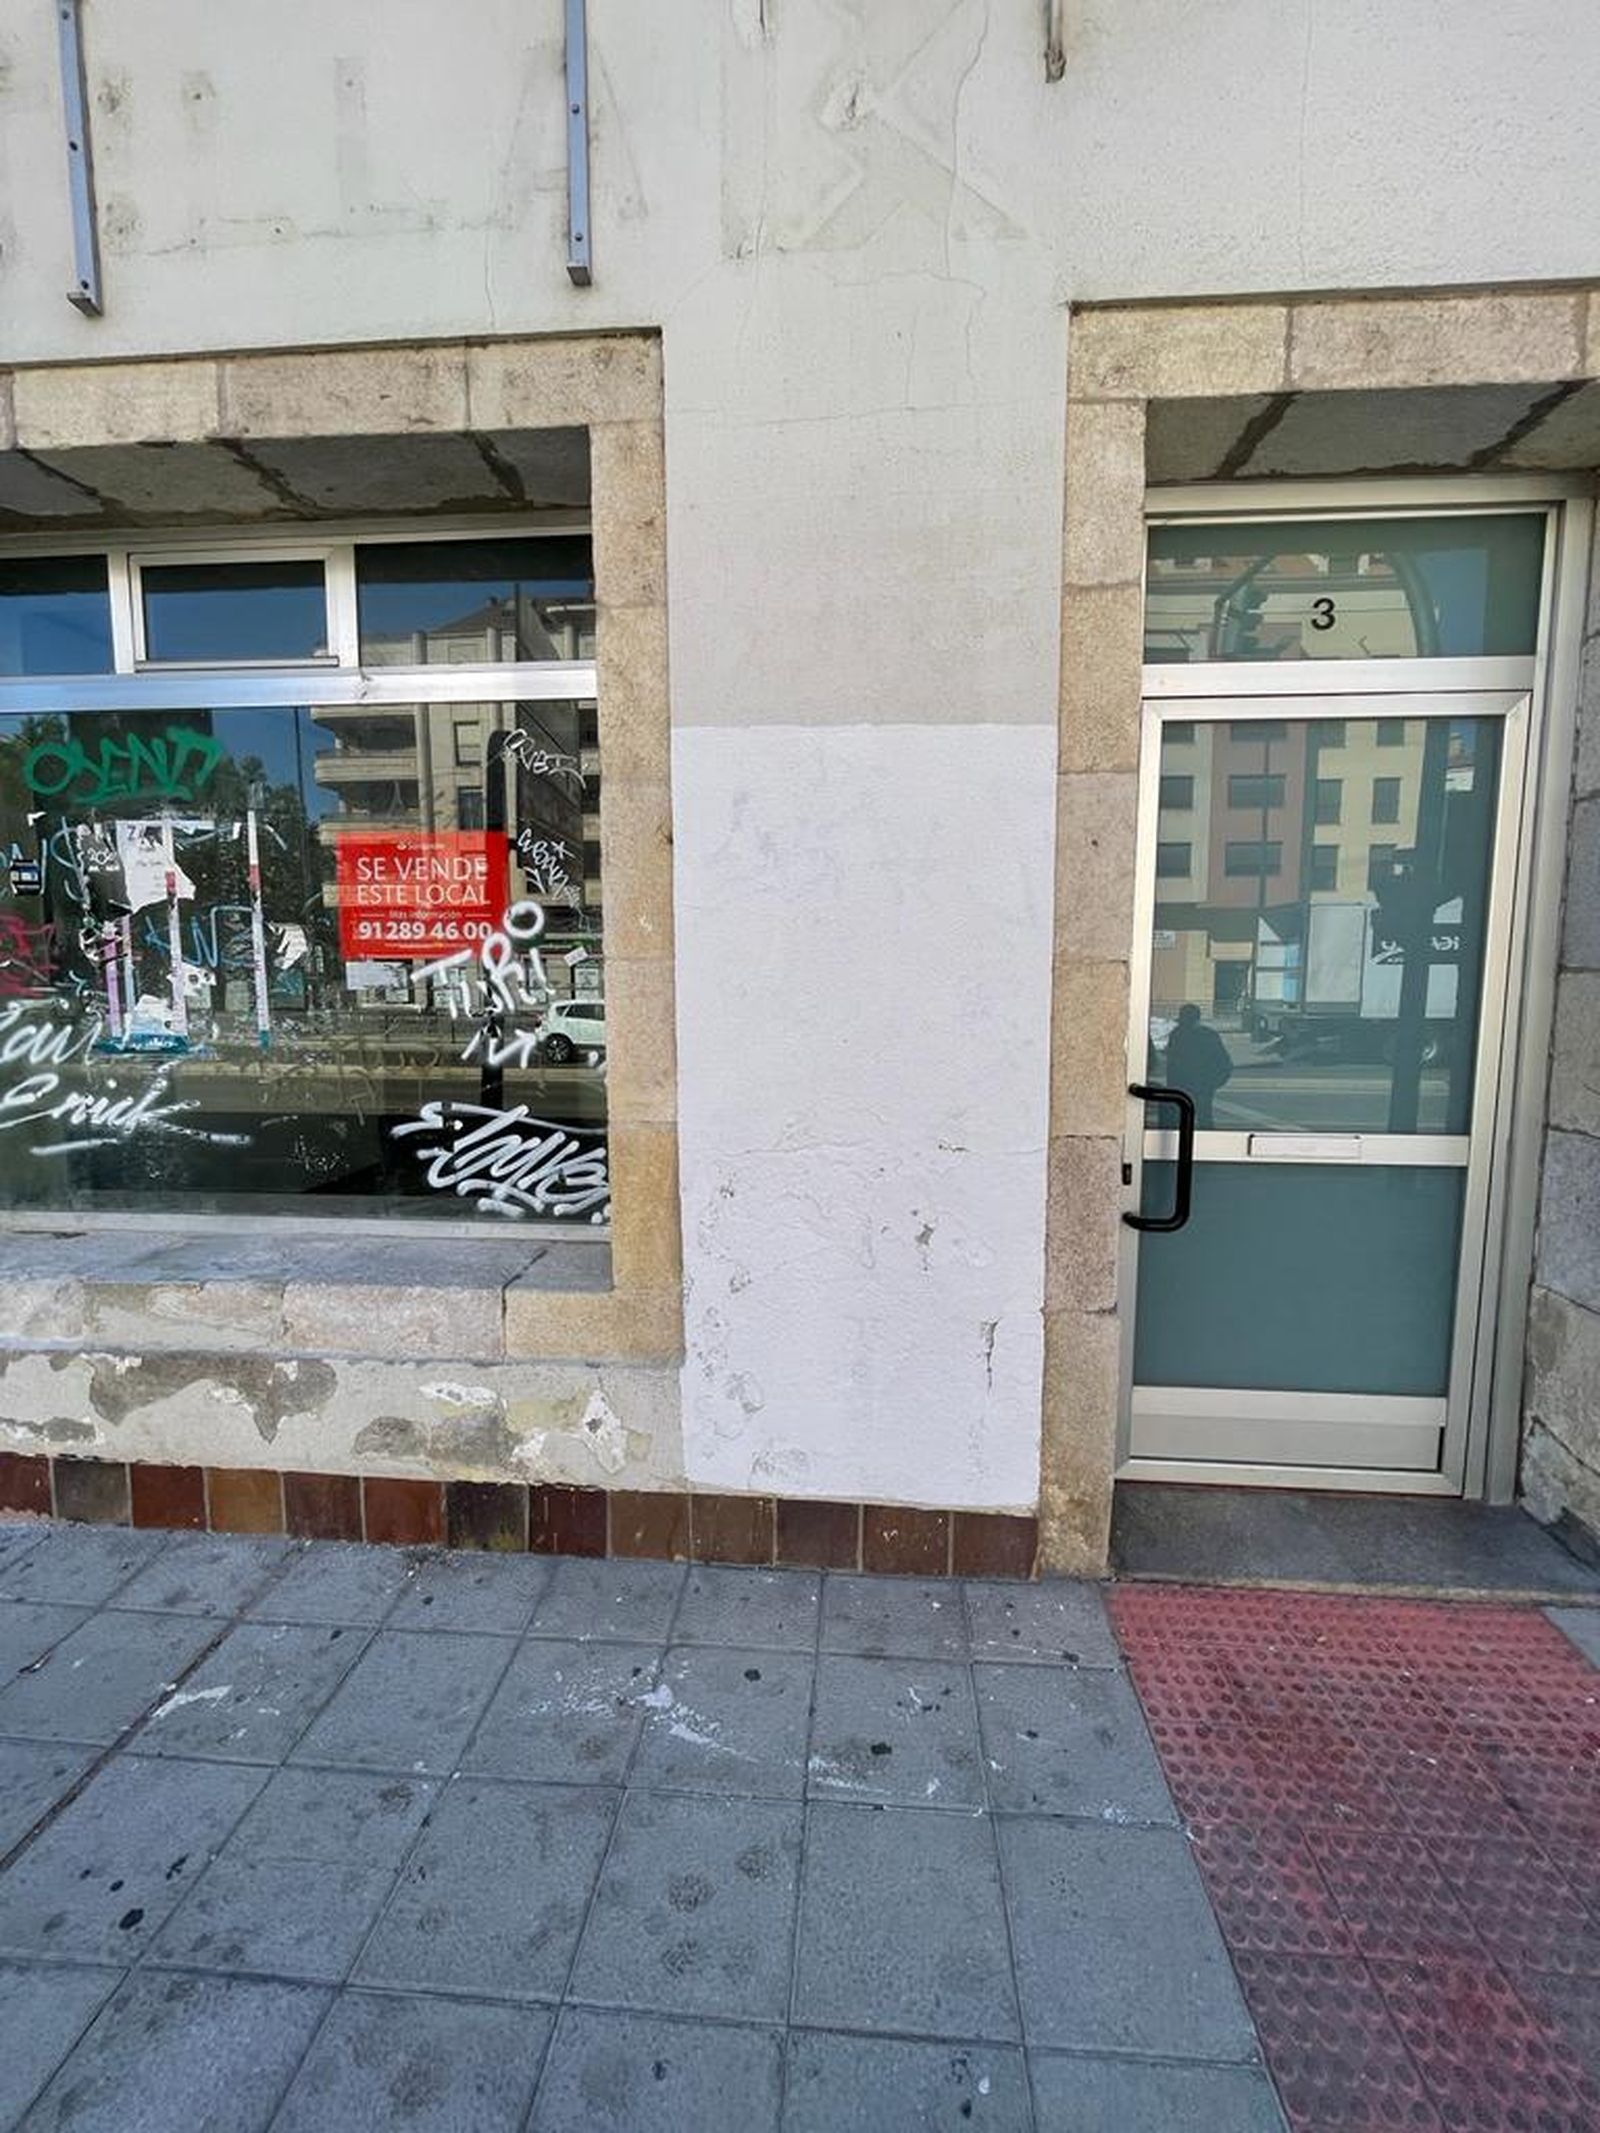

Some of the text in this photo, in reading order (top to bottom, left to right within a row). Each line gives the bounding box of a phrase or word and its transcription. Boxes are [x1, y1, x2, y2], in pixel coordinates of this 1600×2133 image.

[1311, 597, 1336, 631] 3
[357, 857, 488, 880] SE VENDE
[357, 884, 491, 905] ESTE LOCAL
[358, 921, 493, 940] 91 289 46 00
